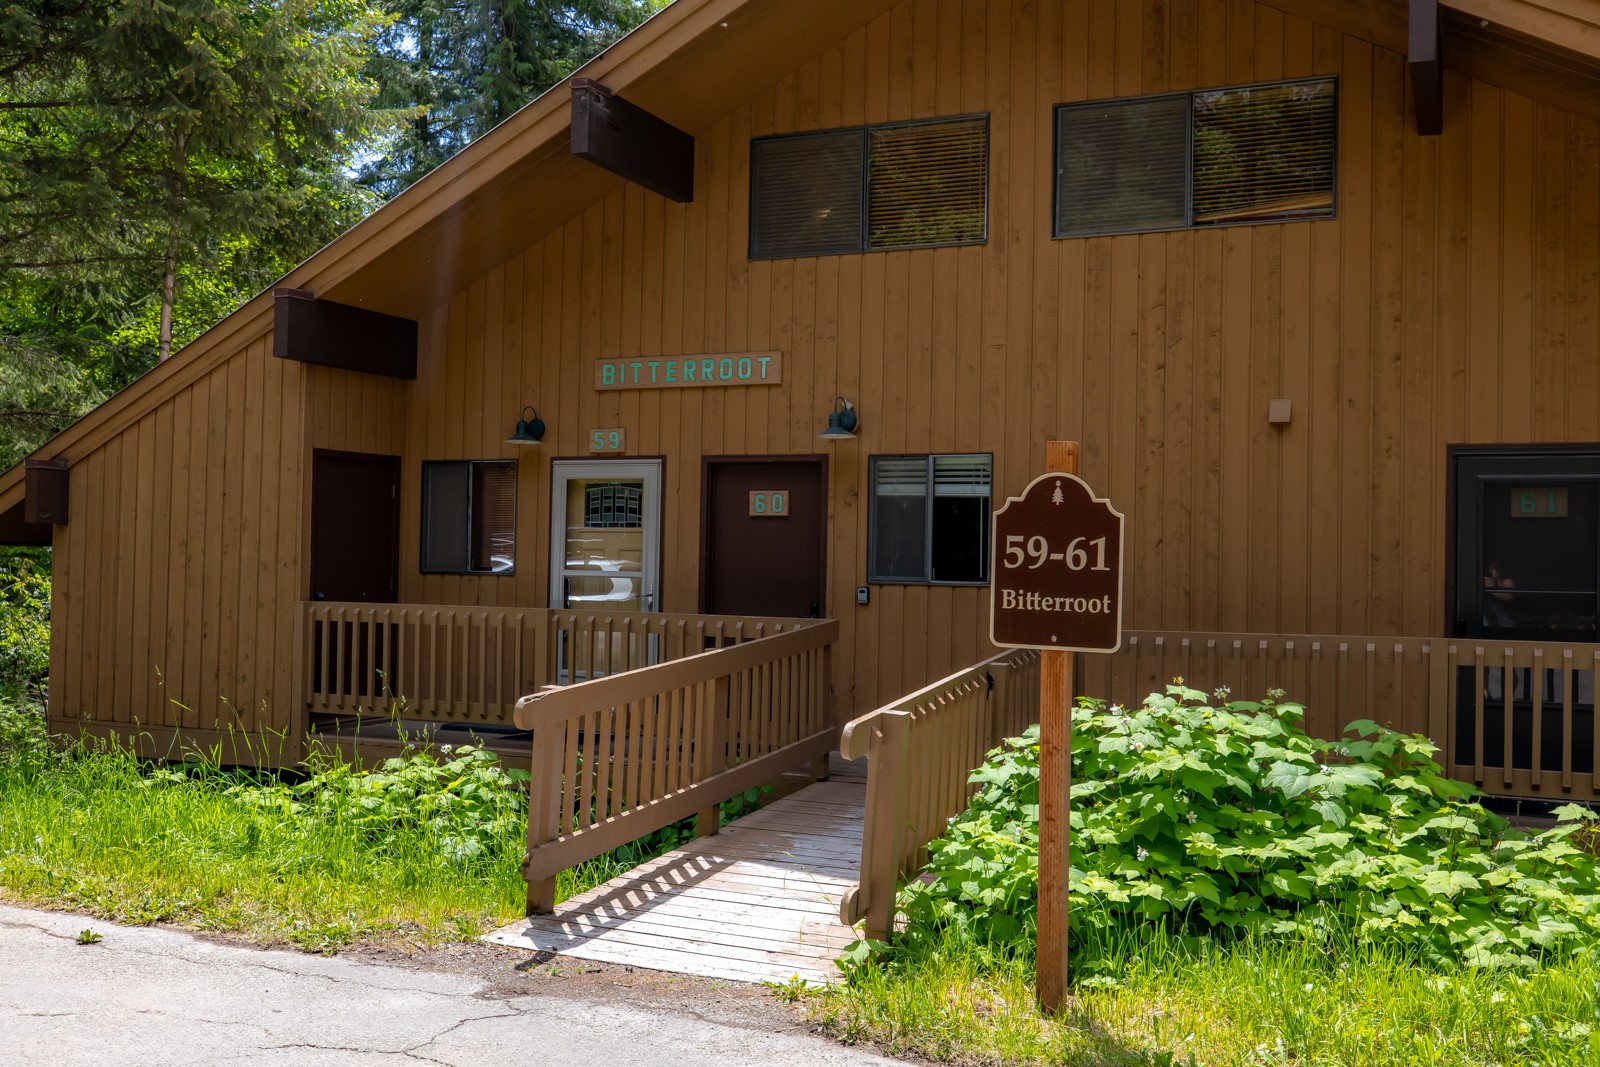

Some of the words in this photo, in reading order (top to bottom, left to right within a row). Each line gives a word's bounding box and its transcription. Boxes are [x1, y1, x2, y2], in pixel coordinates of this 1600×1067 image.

[602, 356, 772, 386] BITTERROOT
[593, 431, 620, 450] 59
[754, 493, 783, 514] 60
[1520, 491, 1556, 514] 61
[1003, 535, 1111, 571] 59-61
[1001, 588, 1111, 614] Bitterroot
